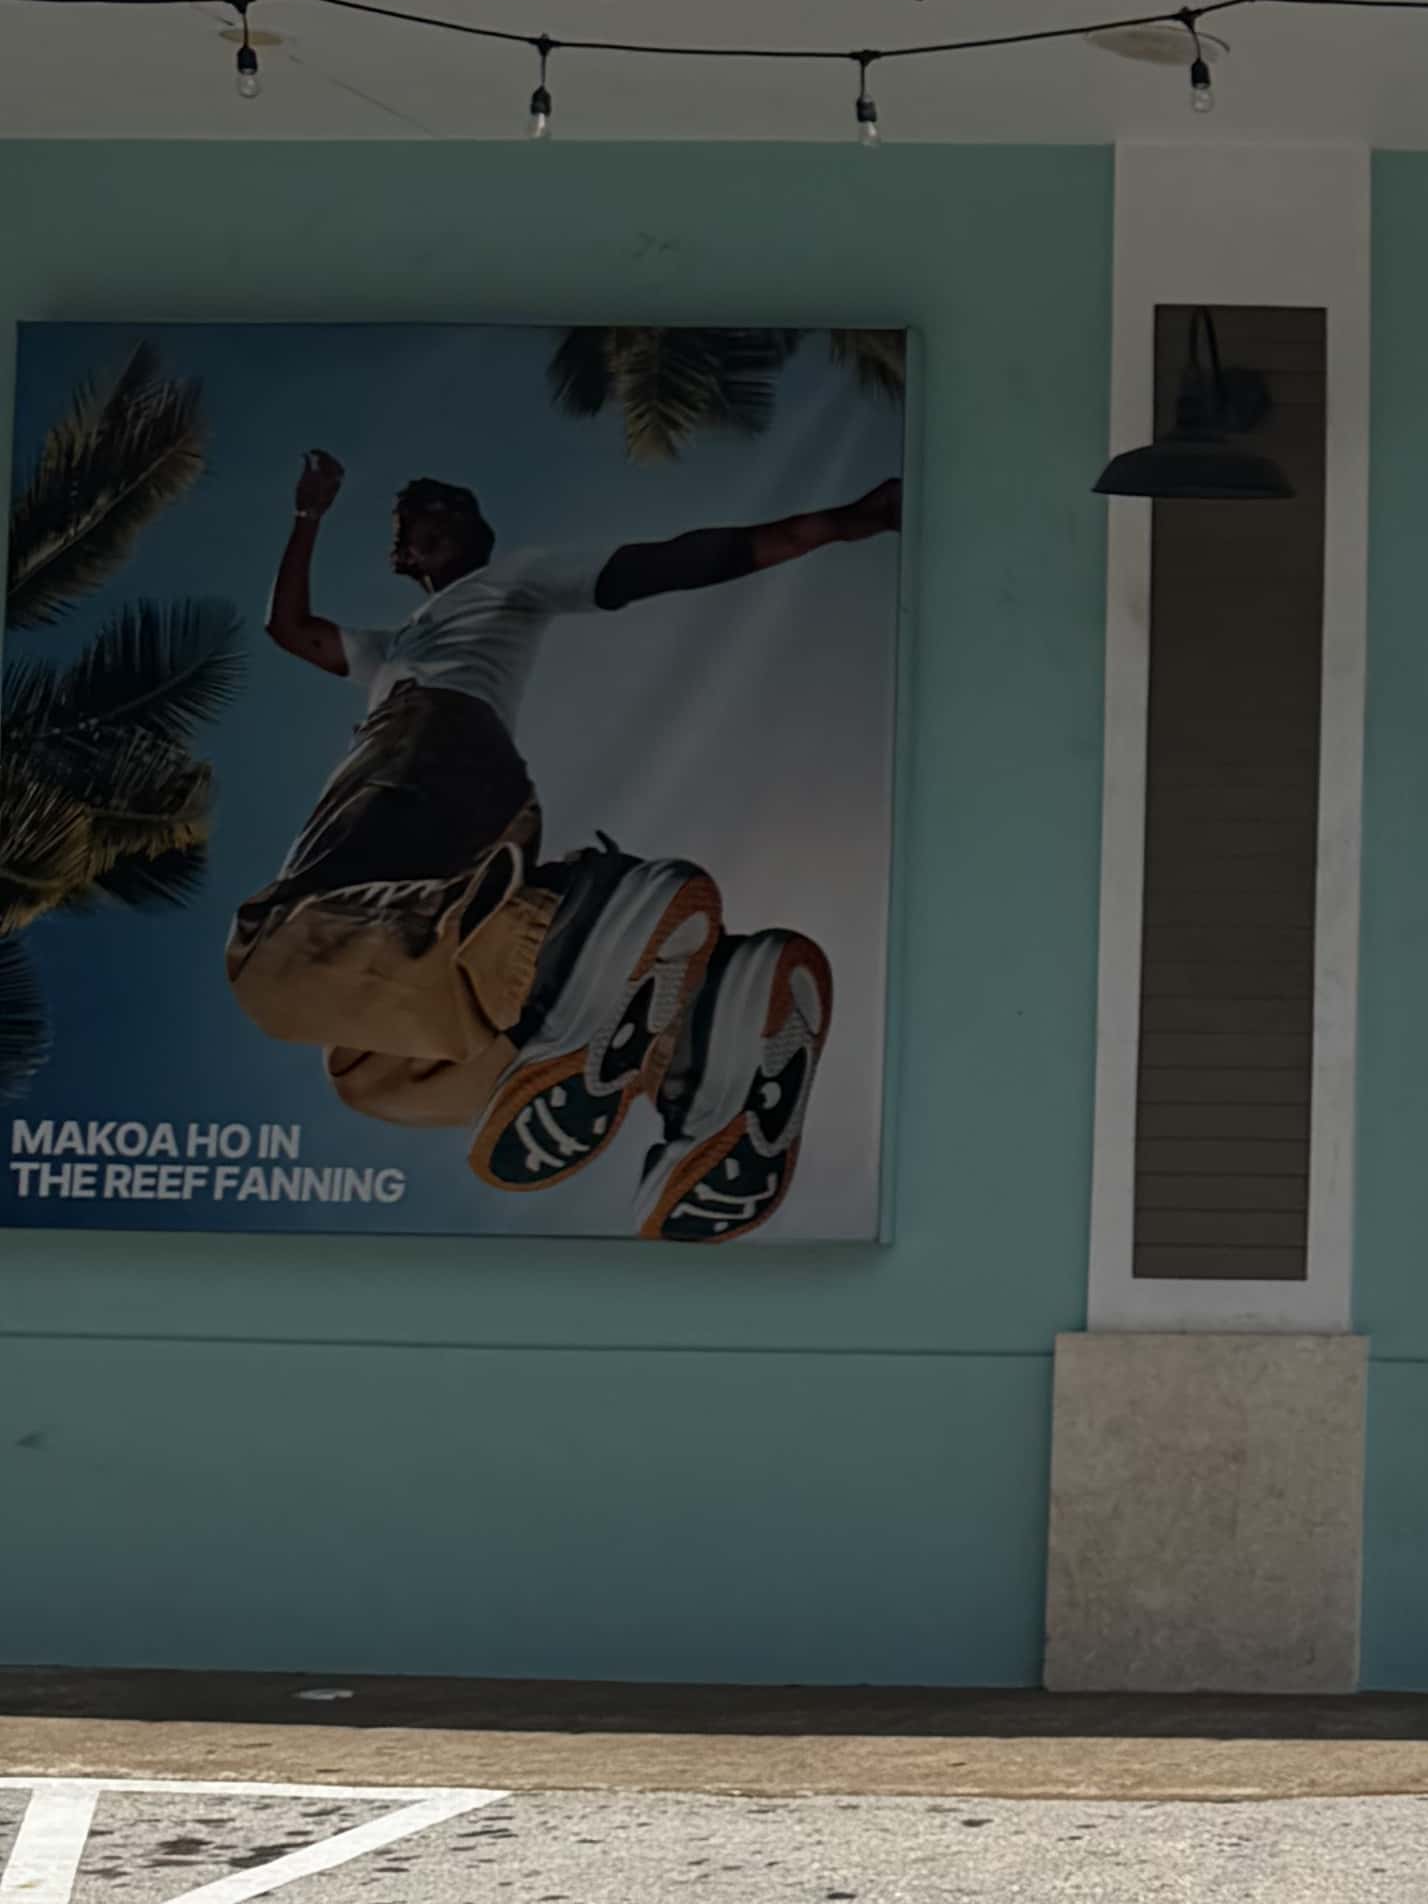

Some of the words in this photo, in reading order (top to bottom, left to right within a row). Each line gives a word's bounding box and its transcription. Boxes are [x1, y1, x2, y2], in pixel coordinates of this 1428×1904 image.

[12, 1119, 179, 1157] MAKOA
[186, 1123, 252, 1159] HO
[257, 1123, 302, 1160] IN
[10, 1161, 98, 1198] THE
[103, 1163, 210, 1200] REEF
[213, 1166, 407, 1203] FANNING
